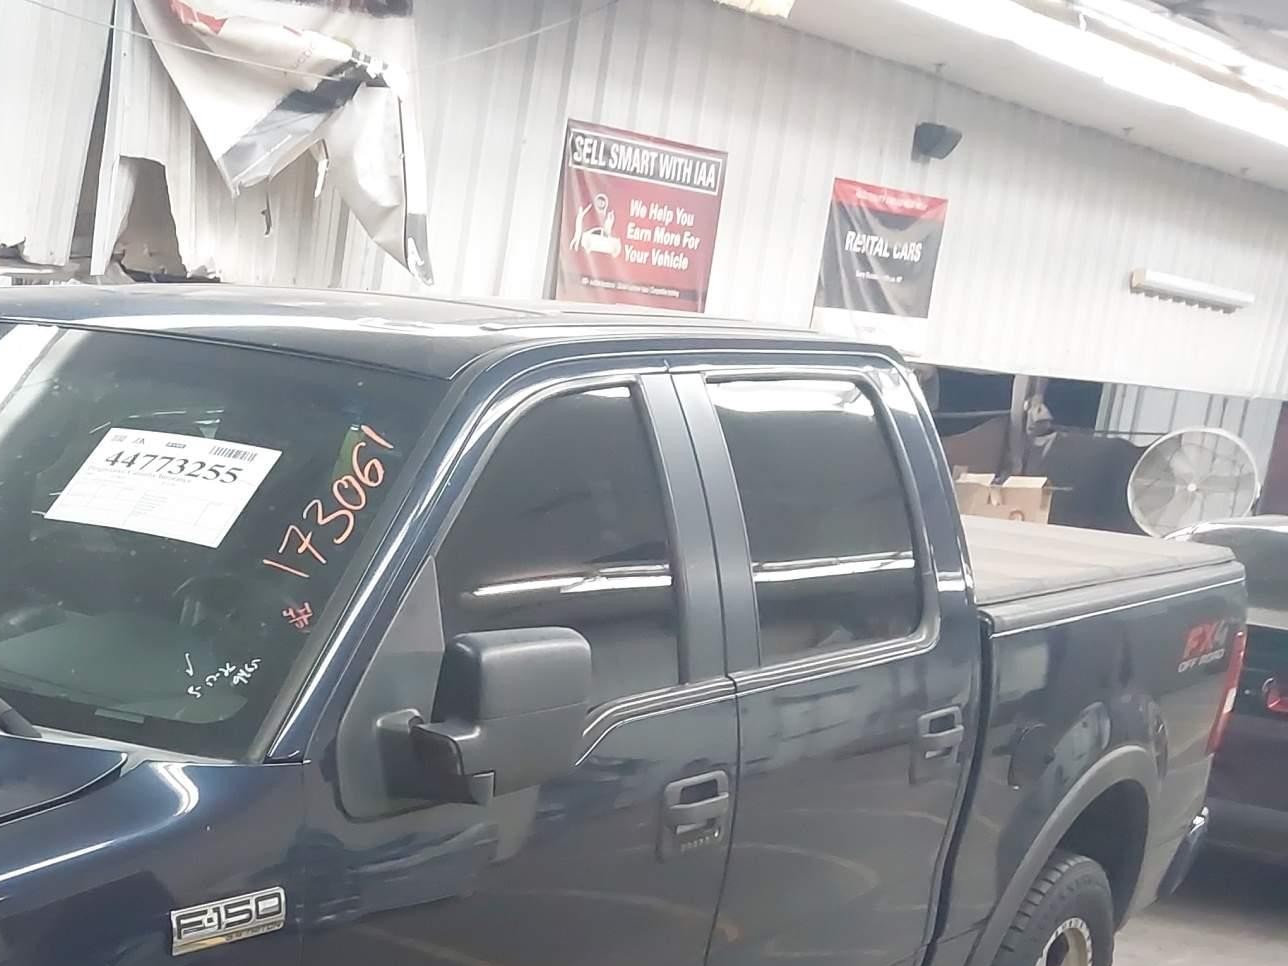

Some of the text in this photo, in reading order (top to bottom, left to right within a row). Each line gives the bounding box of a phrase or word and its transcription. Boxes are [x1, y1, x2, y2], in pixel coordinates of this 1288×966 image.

[573, 135, 716, 189] SELL SMART WITH IAA
[630, 199, 695, 227] We Help You
[626, 222, 701, 250] Earn More For
[844, 230, 922, 262] RENTAL CARS
[624, 244, 689, 271] Your Vehicle
[105, 450, 244, 484] 44773255
[262, 424, 394, 578] 173061
